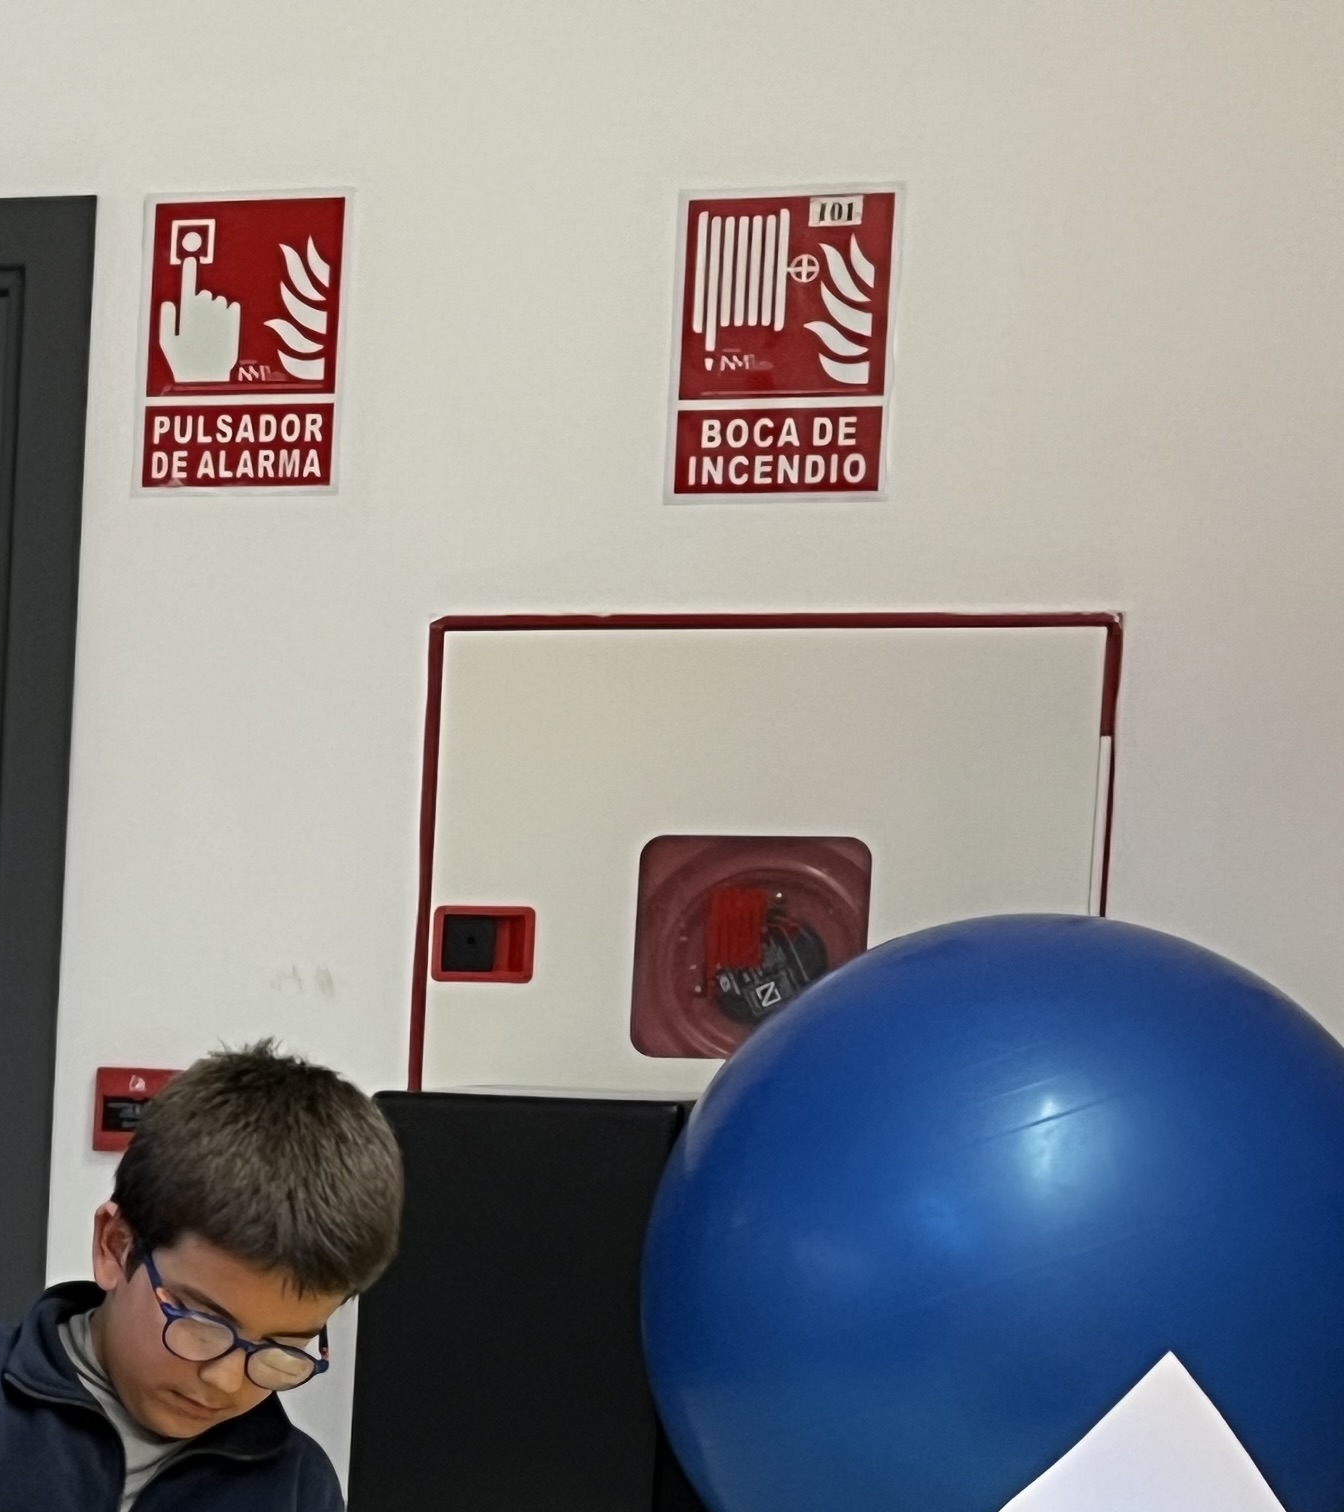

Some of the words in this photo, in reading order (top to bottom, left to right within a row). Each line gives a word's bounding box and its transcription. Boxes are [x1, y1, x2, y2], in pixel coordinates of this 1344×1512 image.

[818, 202, 856, 222] 101
[153, 413, 323, 445] PULSADOR
[701, 417, 800, 449] BOCA
[812, 416, 858, 446] DE
[151, 451, 188, 480] DE
[196, 449, 322, 480] ALARMA
[688, 453, 866, 486] INCENDIO
